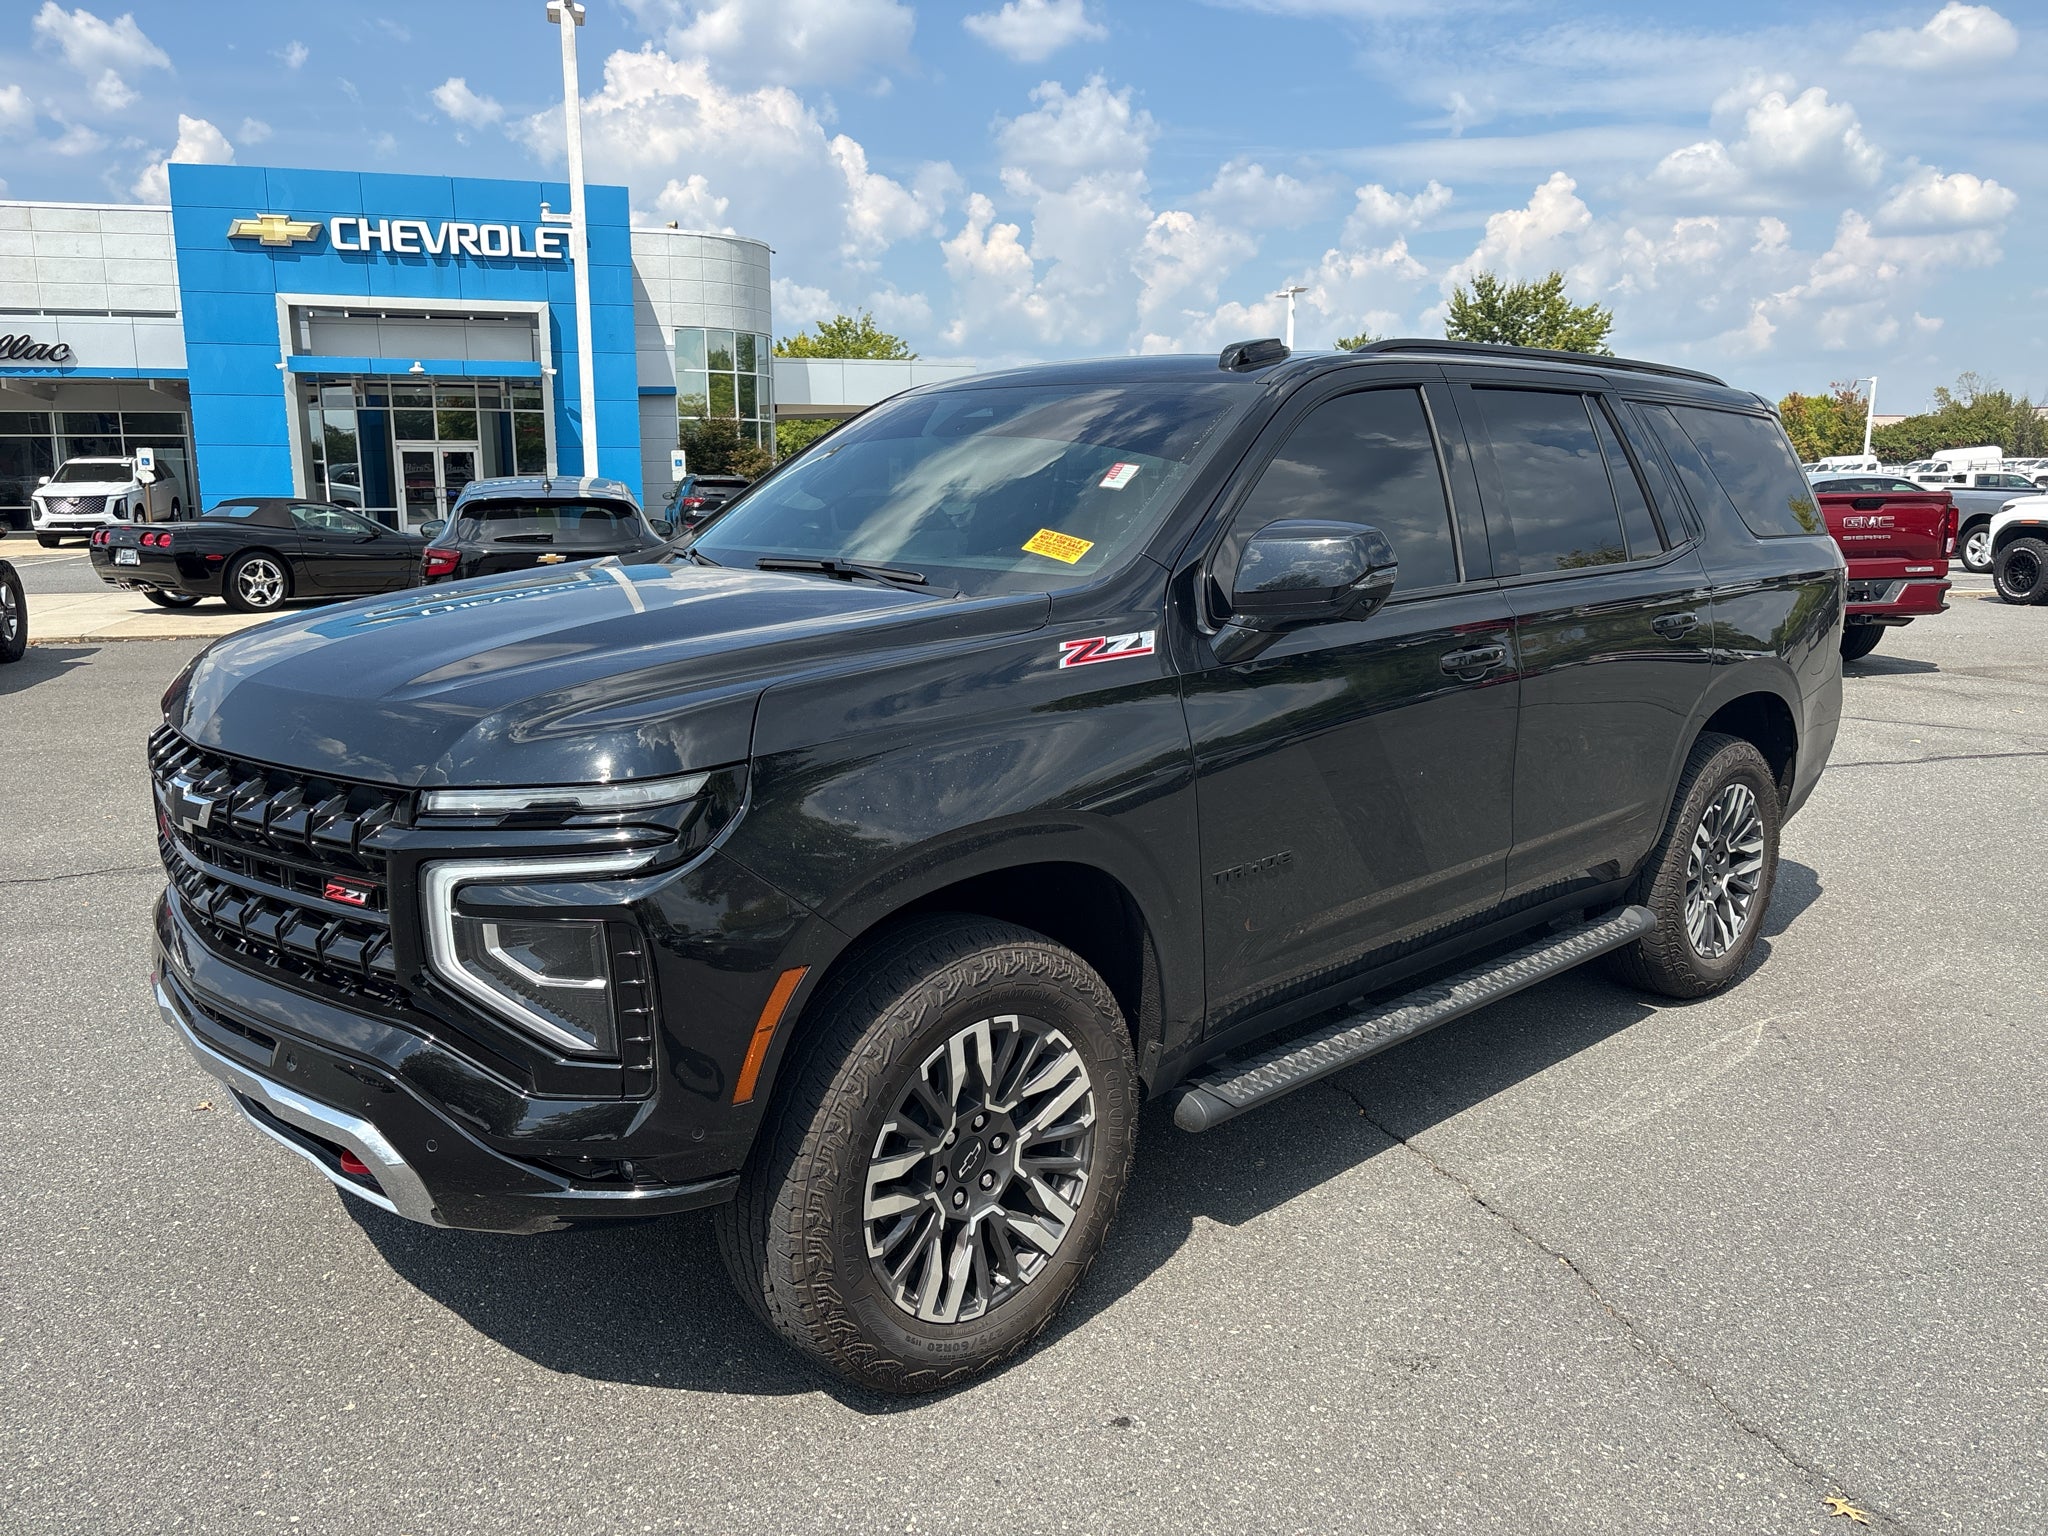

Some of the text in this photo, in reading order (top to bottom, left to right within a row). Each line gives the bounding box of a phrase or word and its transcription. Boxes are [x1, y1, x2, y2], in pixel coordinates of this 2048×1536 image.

[1843, 516, 1895, 528] GMC
[1059, 630, 1155, 669] Z71
[325, 883, 367, 905] Z71
[927, 1327, 1004, 1353] 275/60R20
